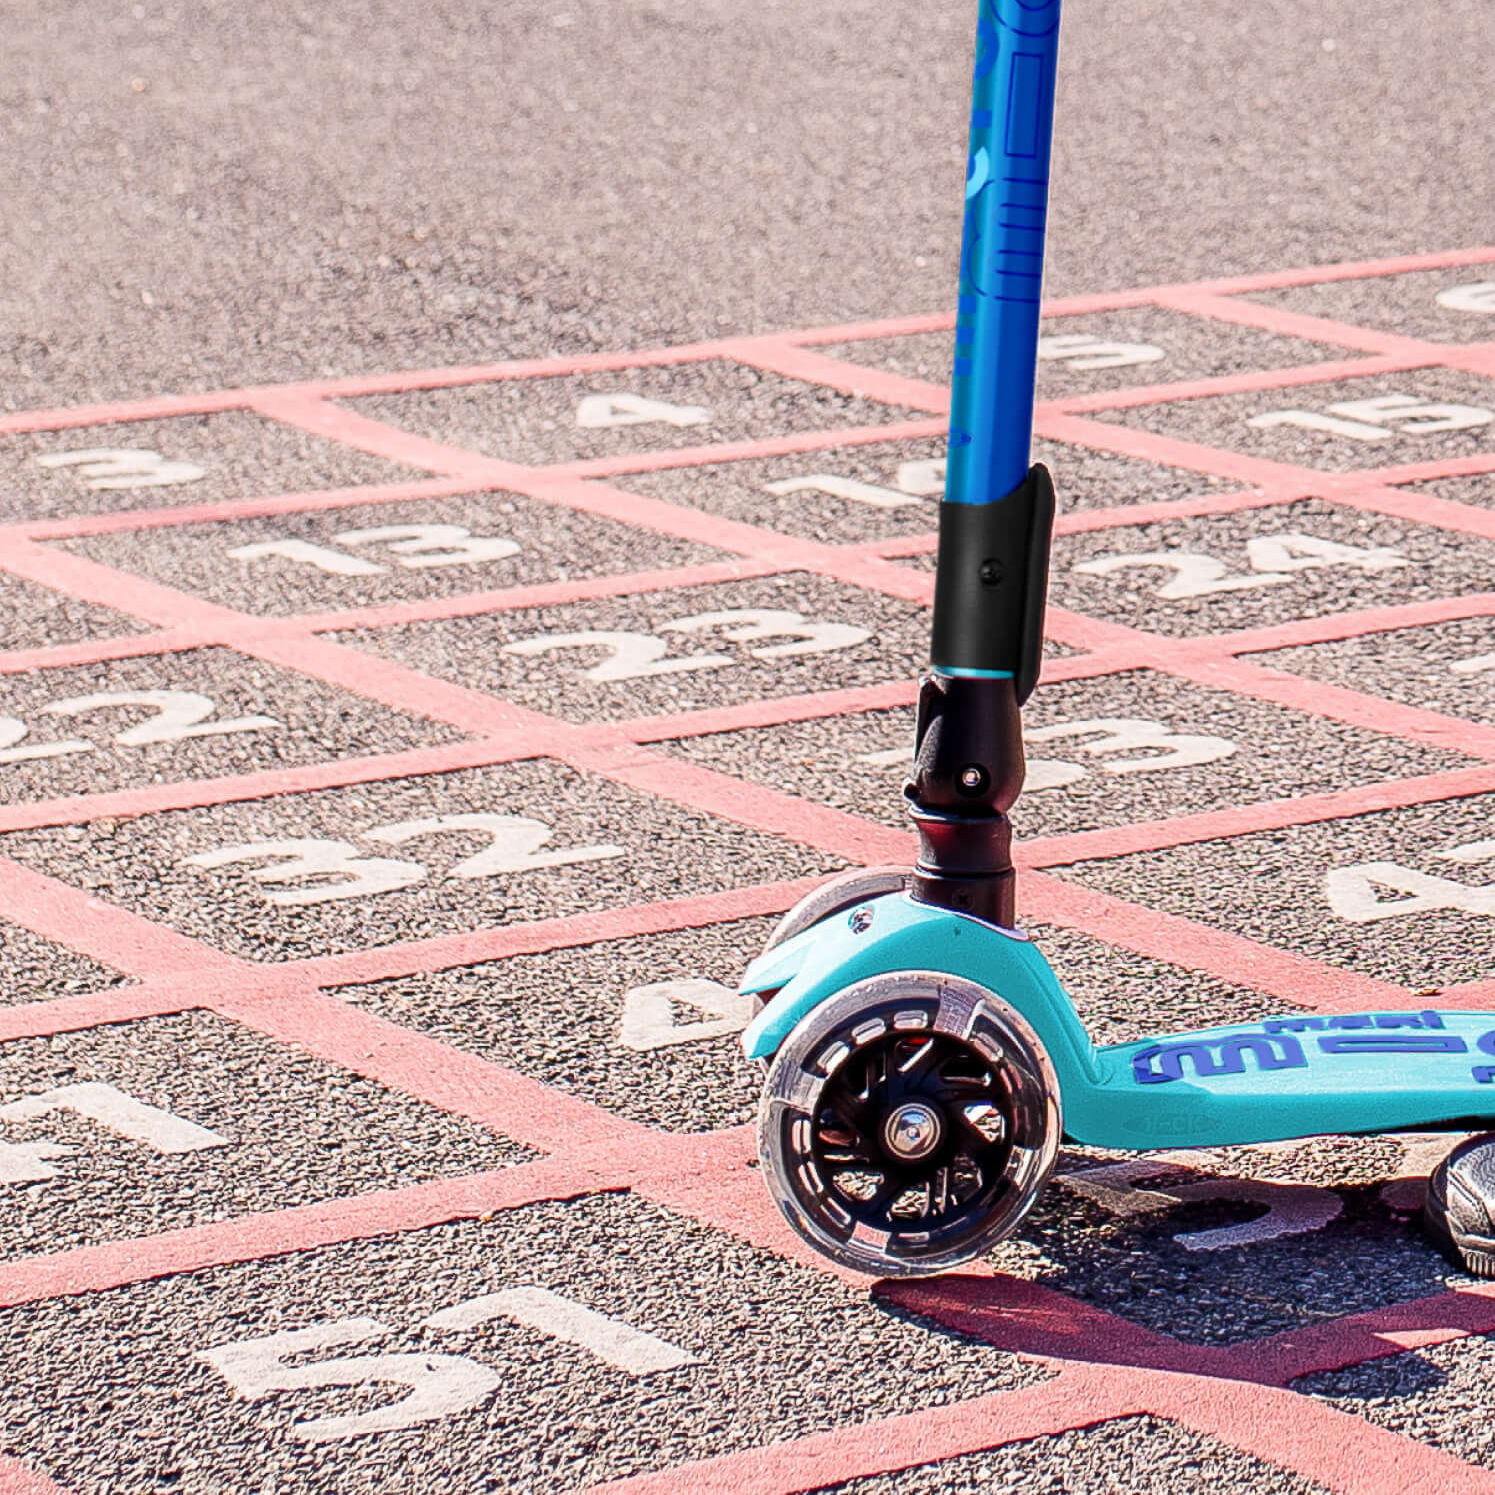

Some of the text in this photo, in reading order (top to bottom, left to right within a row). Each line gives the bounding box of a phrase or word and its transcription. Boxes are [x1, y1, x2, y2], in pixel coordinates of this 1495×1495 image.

[1037, 334, 1166, 370] 5
[575, 392, 712, 429] 4
[1247, 393, 1495, 441] 15
[36, 447, 205, 489] 3
[226, 523, 522, 577] 13
[1073, 533, 1410, 599] 24
[502, 609, 873, 683] 23
[185, 812, 626, 906] 32
[619, 977, 756, 1051] 4
[195, 1285, 702, 1441] 51
